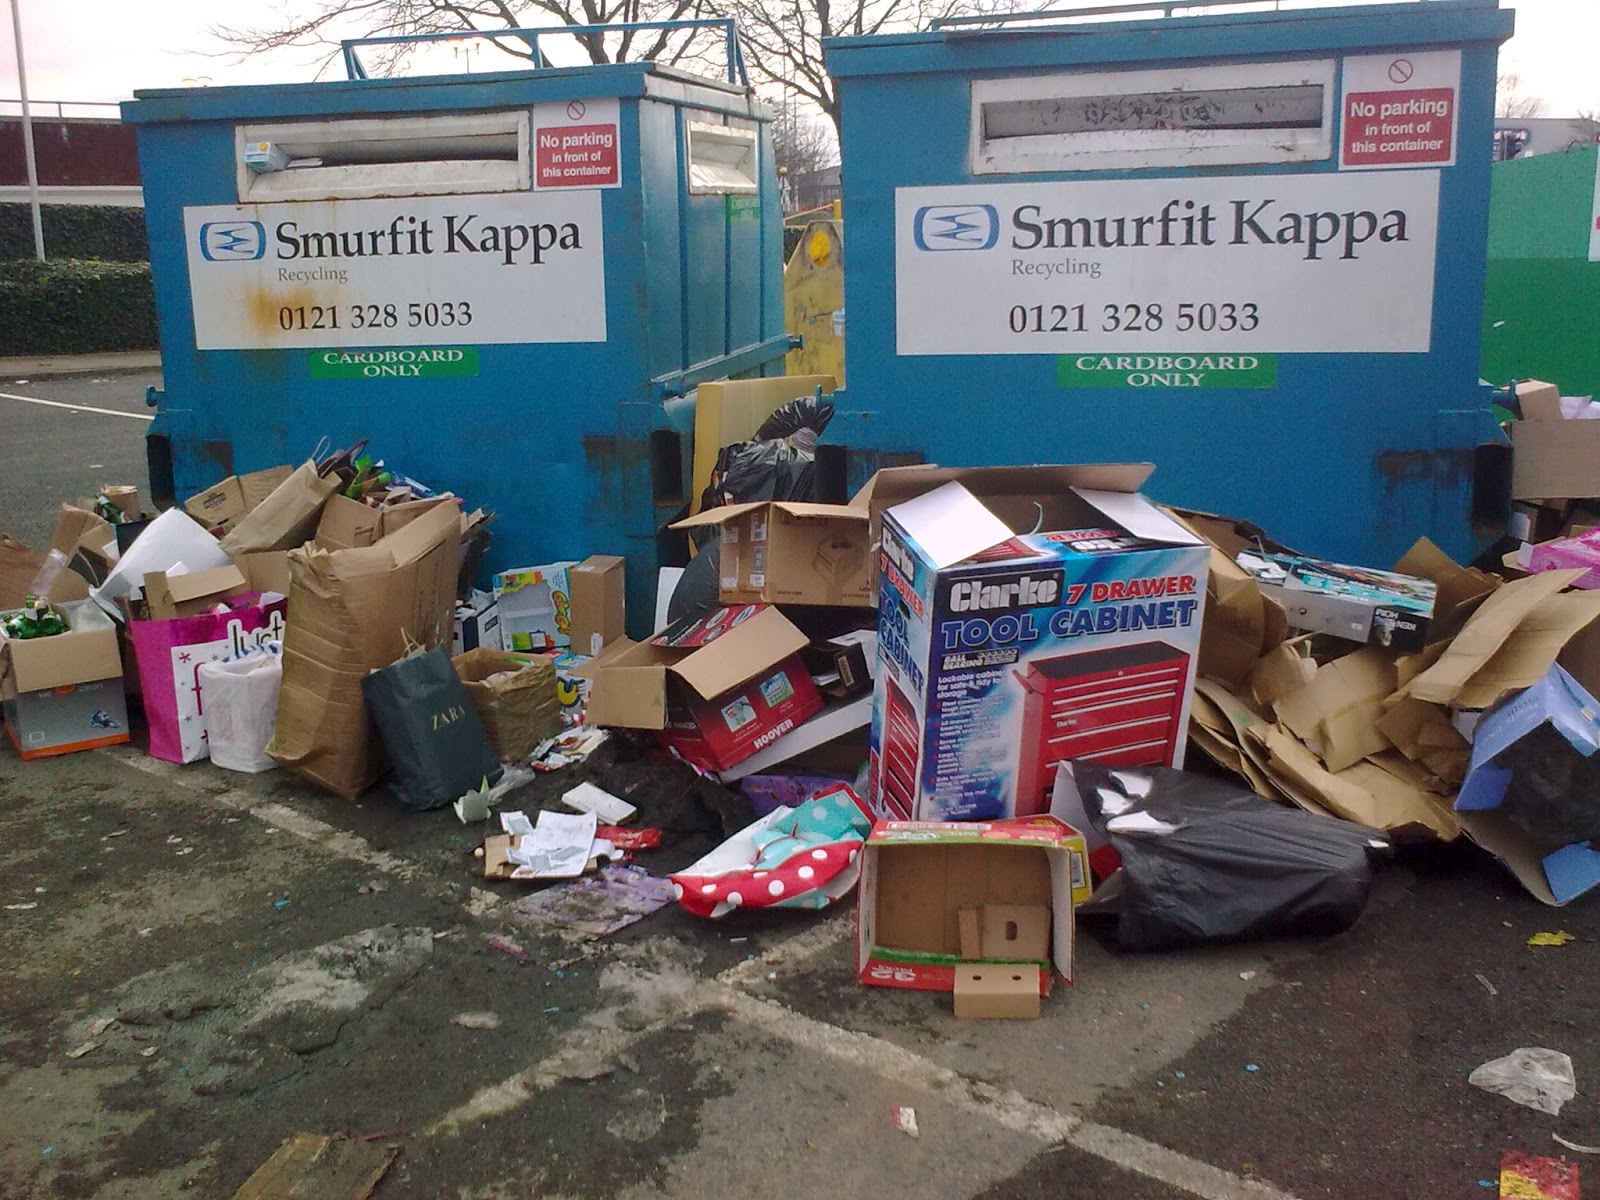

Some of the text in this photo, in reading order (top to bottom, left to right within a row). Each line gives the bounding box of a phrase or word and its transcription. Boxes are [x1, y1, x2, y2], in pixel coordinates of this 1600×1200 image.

[1350, 99, 1448, 120] No parking
[1365, 121, 1431, 136] in front of
[541, 132, 613, 150] No parking
[1352, 139, 1443, 153] this container
[552, 150, 602, 163] in front of
[542, 165, 611, 177] this container
[1011, 199, 1409, 260] Smurfit Kappa
[276, 214, 582, 266] Smurfit Kappa
[278, 266, 347, 284] Recycling
[1011, 258, 1101, 280] Recycling
[279, 301, 473, 331] 0121 328 5033
[1009, 301, 1260, 334] 0121 328 5033
[323, 349, 464, 365] CARDBOARD
[1076, 355, 1259, 372] CARDBOARD
[362, 363, 424, 378] ONLY
[1127, 371, 1205, 388] ONLY
[880, 553, 888, 573] 7
[950, 576, 1057, 612] Clarke
[1068, 575, 1197, 604] 7 DRAWER
[941, 600, 1197, 649] TOOL CABINET
[938, 669, 1006, 684] Lockable cabine
[937, 683, 948, 691] for
[950, 681, 968, 690] safe
[937, 689, 967, 699] storage
[432, 704, 466, 731] ZARA
[753, 718, 794, 750] HOOVER
